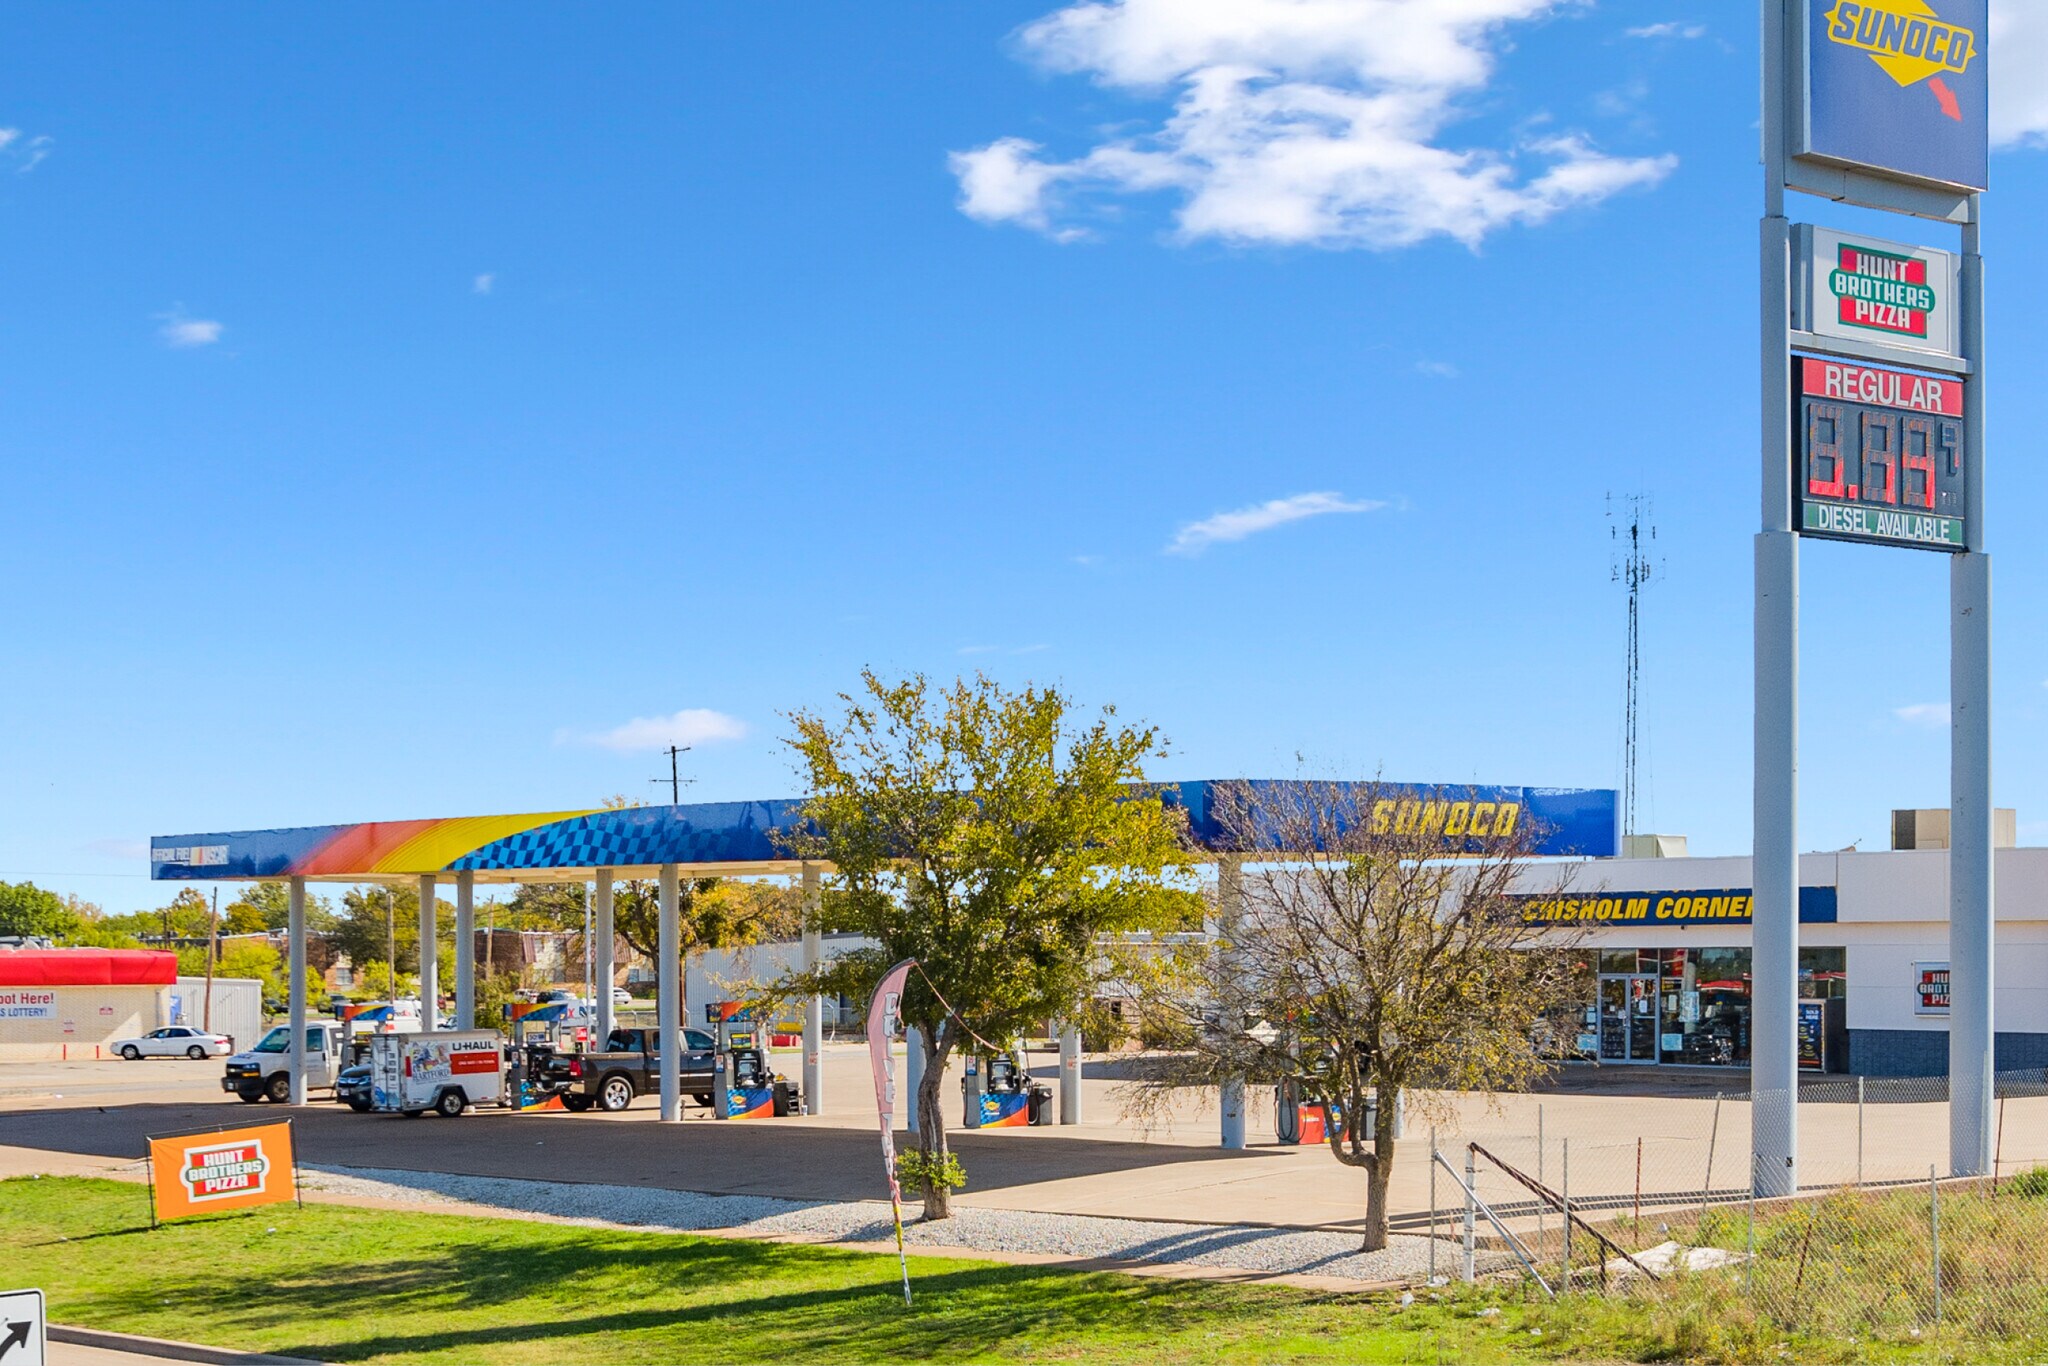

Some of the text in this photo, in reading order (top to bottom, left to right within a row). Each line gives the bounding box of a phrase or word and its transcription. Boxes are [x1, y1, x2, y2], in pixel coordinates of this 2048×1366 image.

[1832, 2, 1970, 68] SUNOCO
[1856, 253, 1909, 283] HUNT
[1835, 273, 1930, 309] BROTHERS
[1855, 299, 1910, 329] PIZZA
[1825, 365, 1943, 412] REGULAR
[1818, 505, 1950, 543] DIESEL AVAILABLE
[1371, 799, 1519, 837] SUNOCO
[1521, 899, 1650, 921] CHISHOLM
[20, 993, 54, 1004] Here!
[8, 1008, 47, 1017] LOTTERY!
[452, 1041, 494, 1051] U-HAUL
[188, 1160, 262, 1182] BROTHERS
[203, 1150, 244, 1166] HUNT
[205, 1174, 249, 1192] PIZZA
